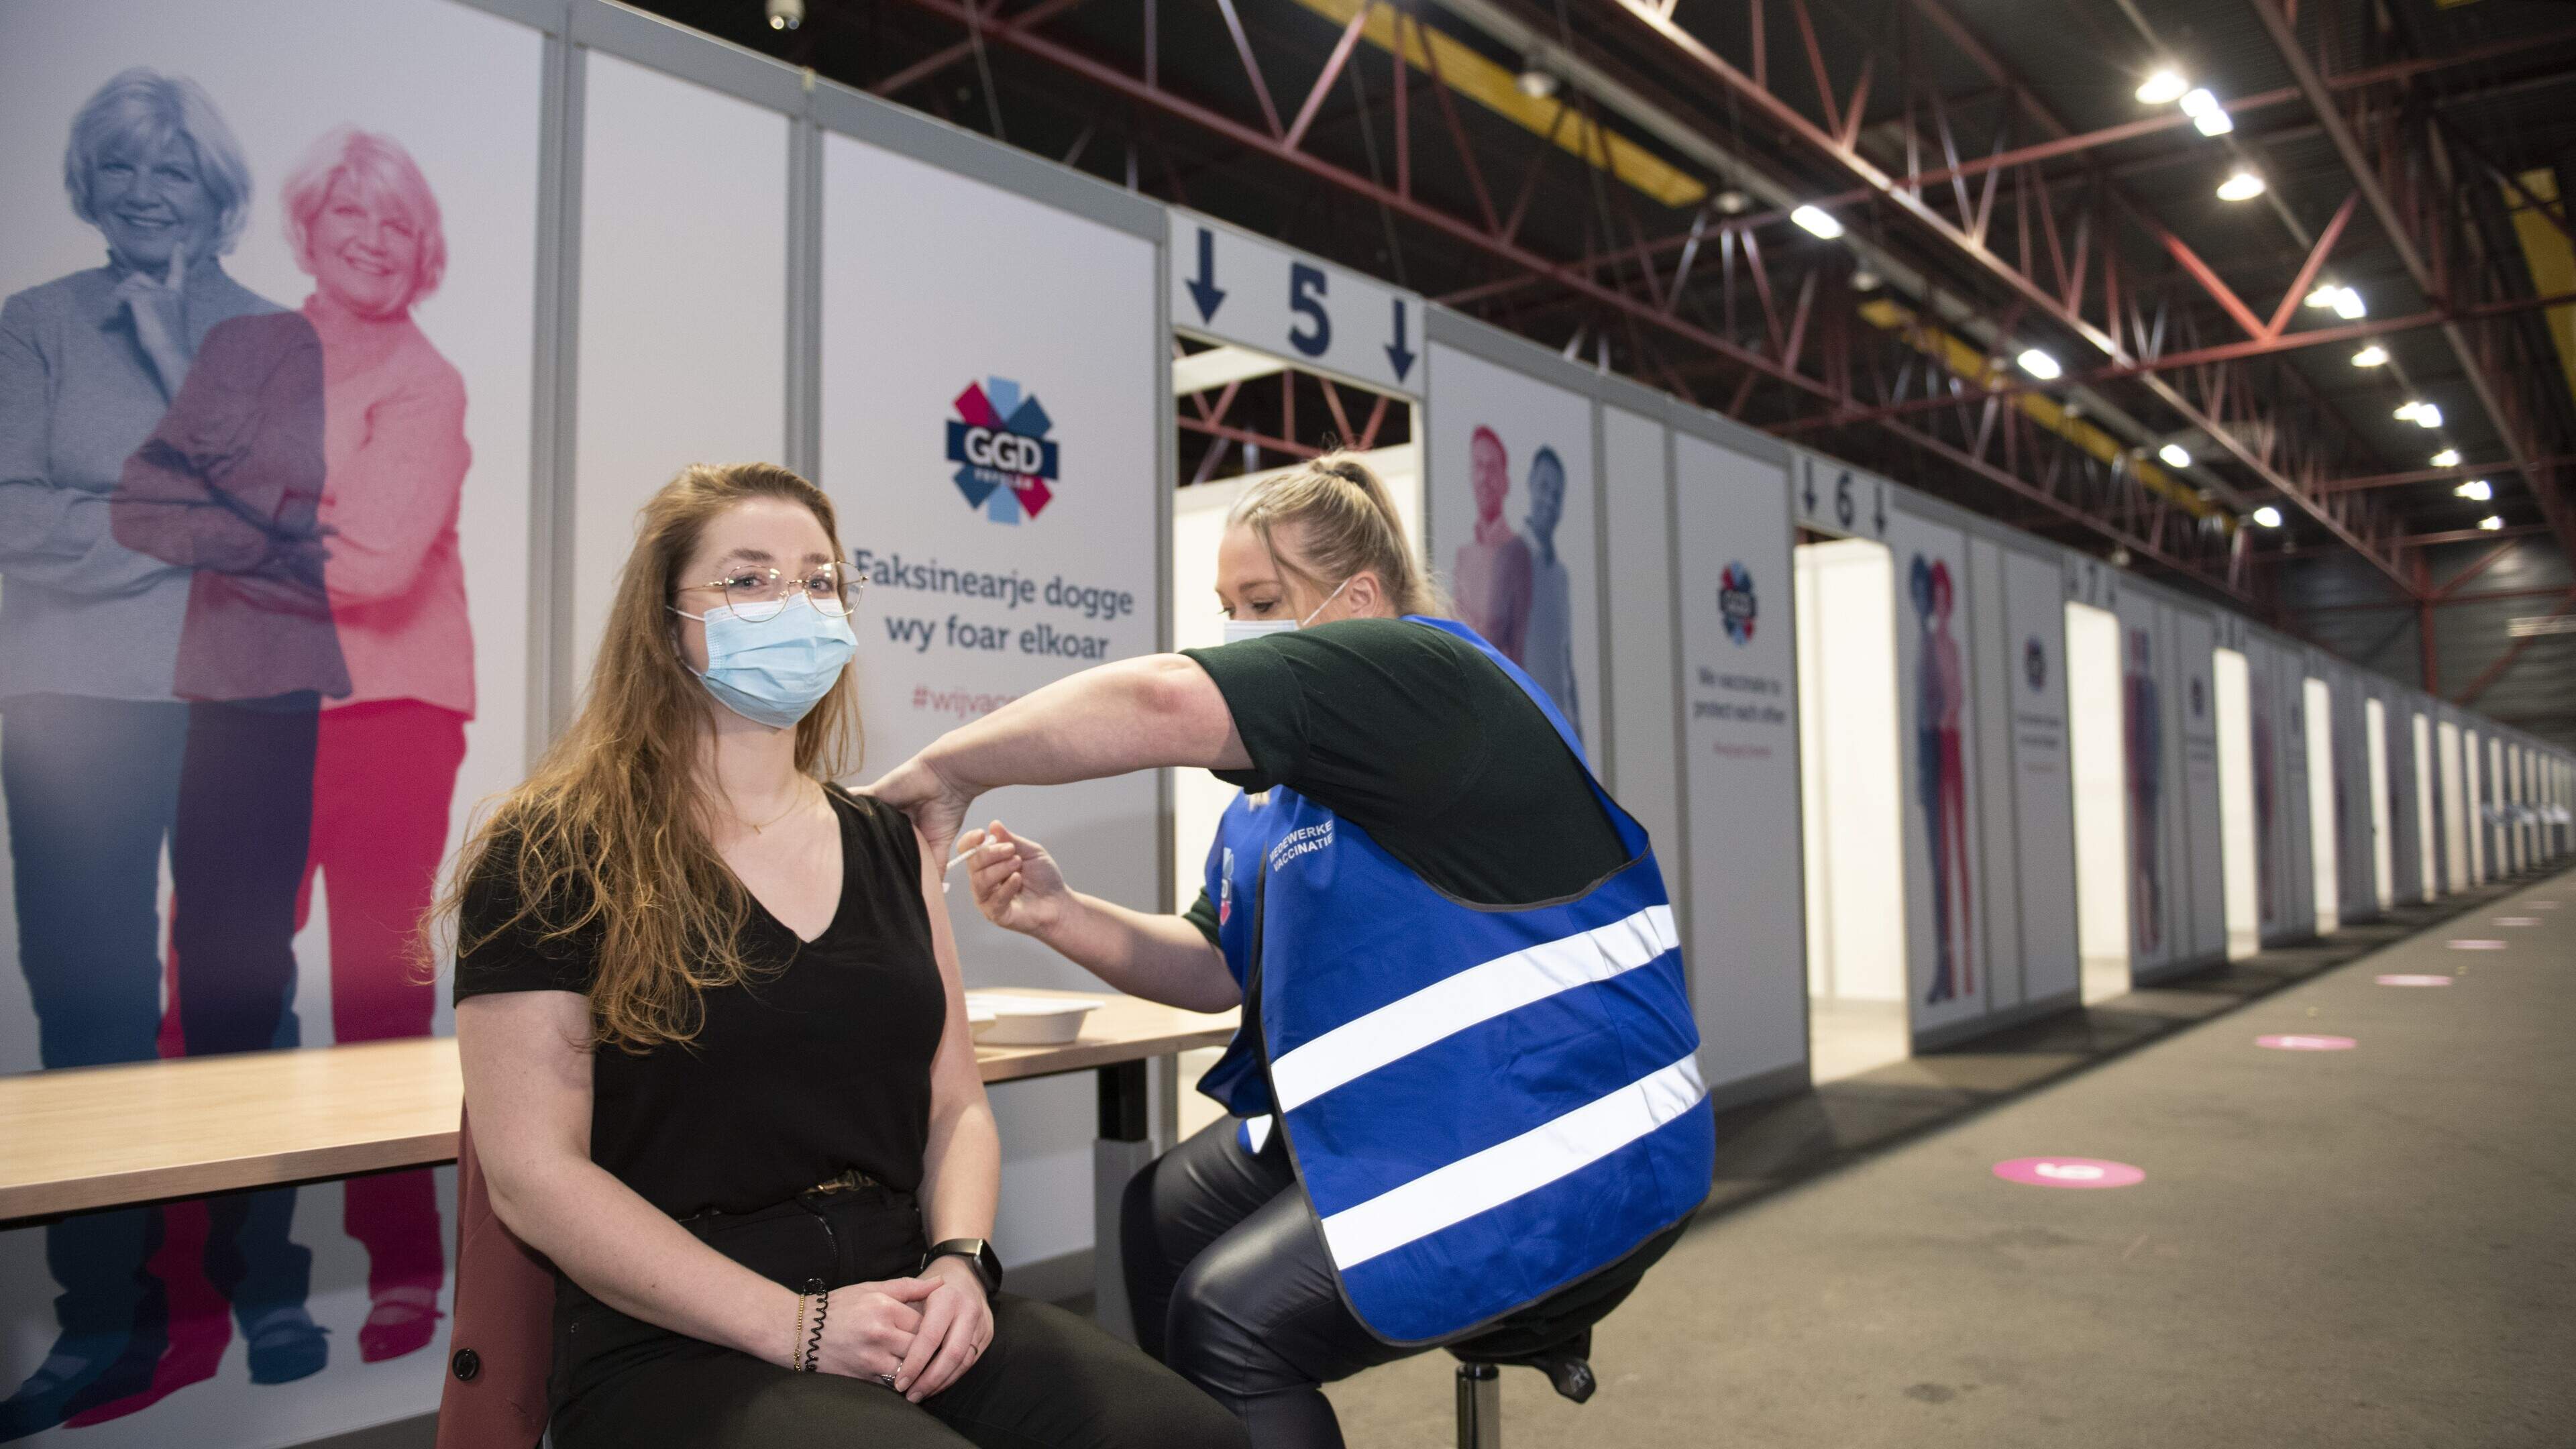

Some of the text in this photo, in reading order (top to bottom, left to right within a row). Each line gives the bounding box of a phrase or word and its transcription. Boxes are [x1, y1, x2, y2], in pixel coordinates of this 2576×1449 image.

[1289, 262, 1330, 357] 5
[964, 427, 1043, 474] GGD
[1835, 470, 1854, 529] 6
[855, 549, 1134, 621] Faksinearje dogge
[885, 614, 1110, 660] wy foar elkoar
[912, 684, 1018, 719] #wijvac
[1269, 820, 1333, 863] MEDEWERKE
[1273, 833, 1333, 871] VACCINATIE
